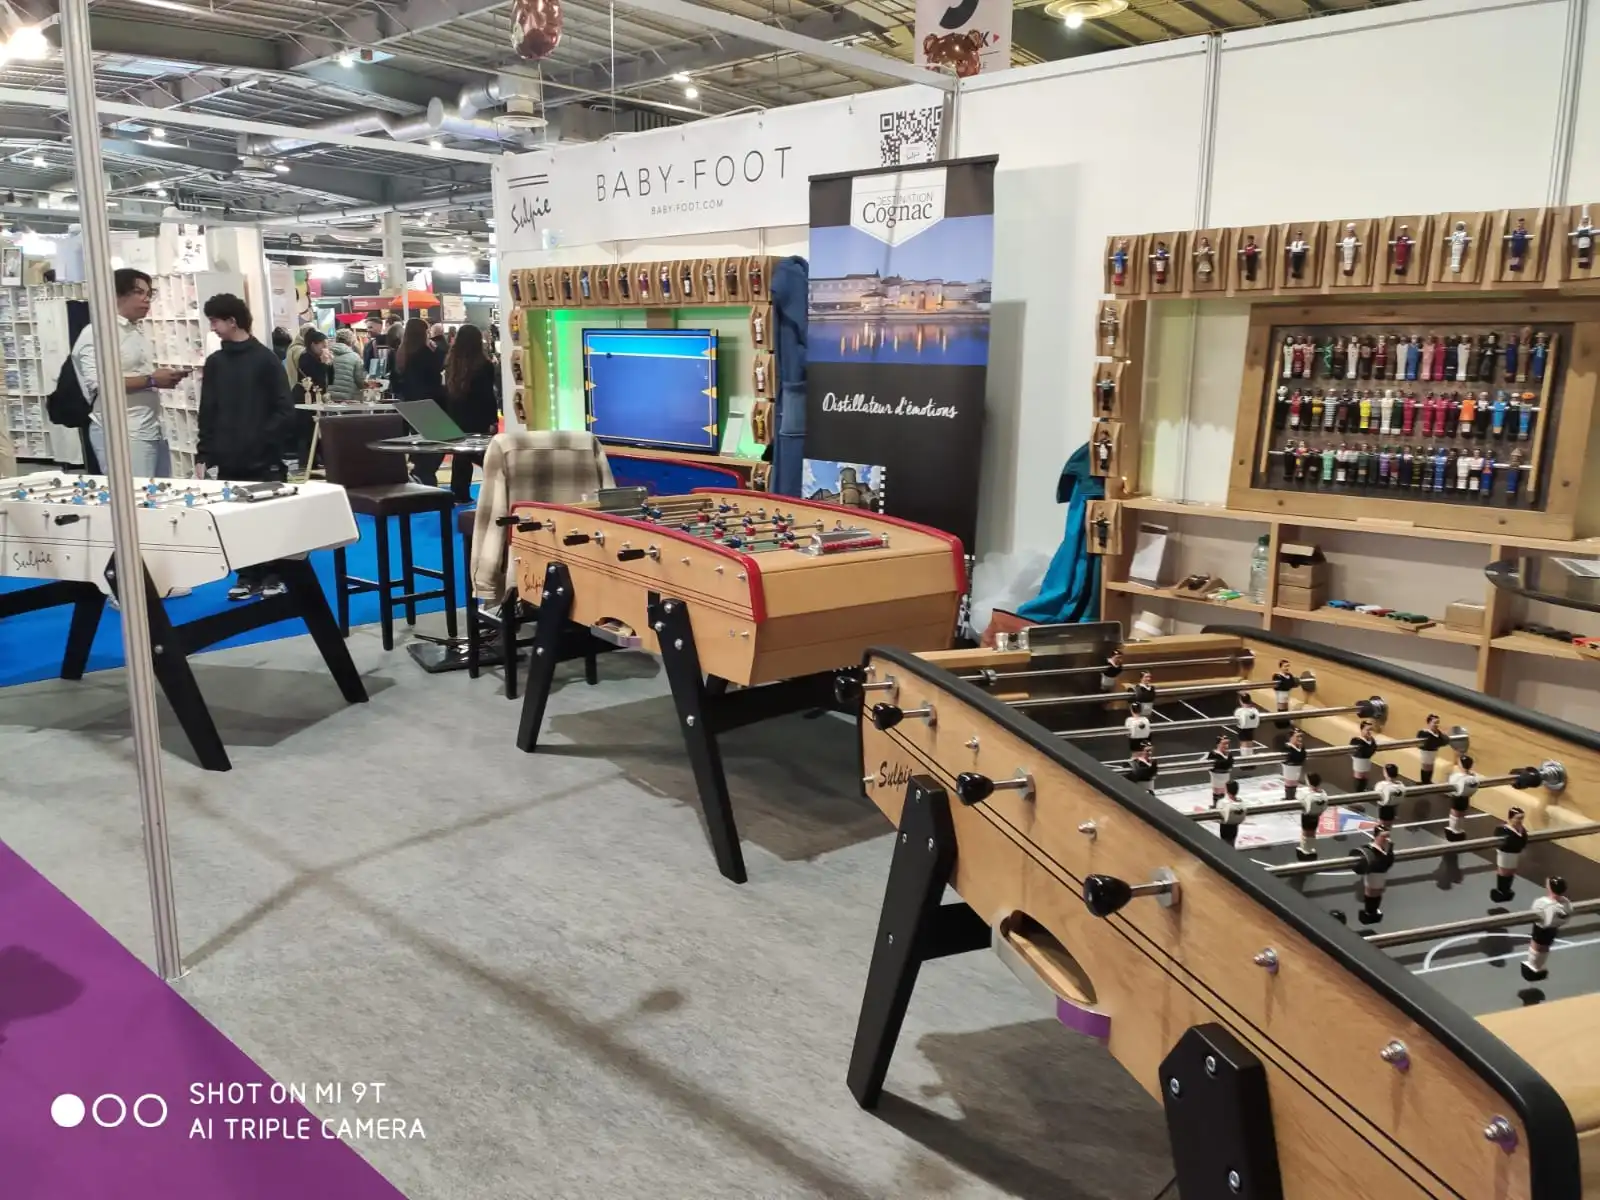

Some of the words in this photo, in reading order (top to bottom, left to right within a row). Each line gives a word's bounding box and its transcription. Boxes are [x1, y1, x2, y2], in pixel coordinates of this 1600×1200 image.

[596, 146, 792, 202] BABY-FOOT
[651, 199, 724, 215] BABY-FOOT.COM
[876, 192, 933, 206] DESTINATION
[511, 196, 551, 233] Sulpie
[863, 202, 933, 228] Cognac
[822, 392, 893, 414] Distillateur
[894, 396, 958, 419] d'émotions
